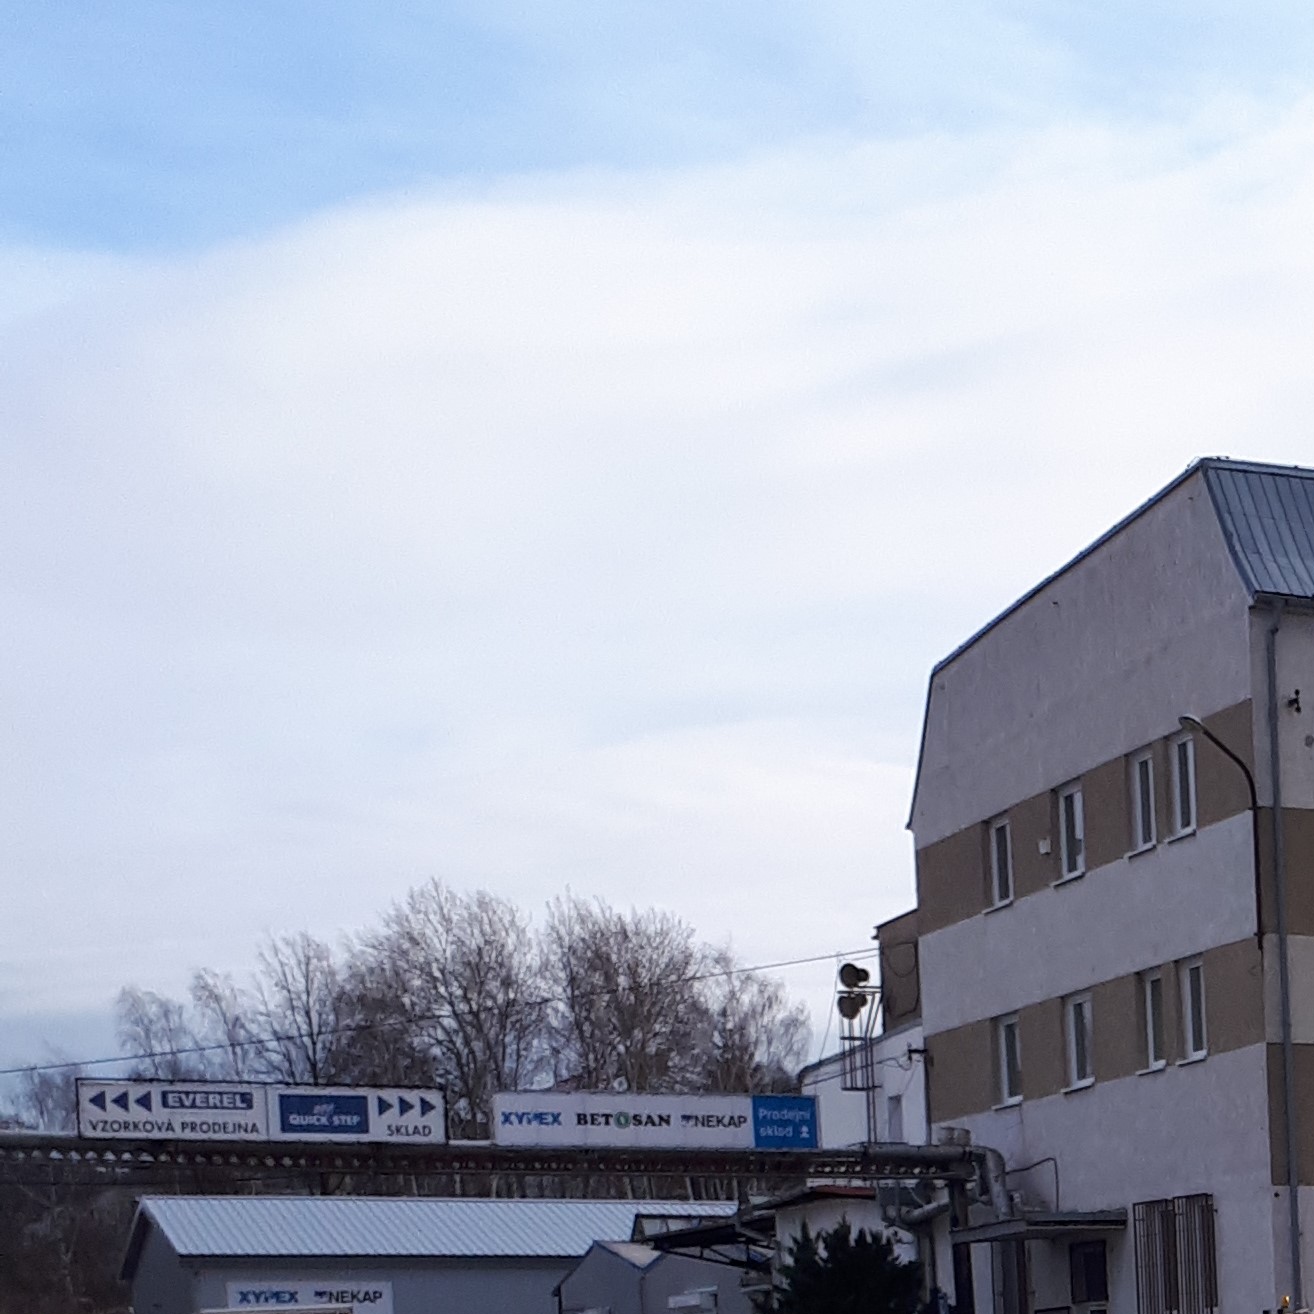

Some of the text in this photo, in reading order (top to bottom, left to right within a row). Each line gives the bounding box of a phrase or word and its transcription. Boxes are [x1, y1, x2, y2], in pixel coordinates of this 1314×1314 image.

[168, 1092, 248, 1108] EVEREL
[89, 1117, 260, 1135] VZORKOVÁ PRODEJNA
[576, 1111, 672, 1129] BETOSAN
[695, 1114, 747, 1128] NEKAP
[387, 1124, 432, 1137] SKLAD
